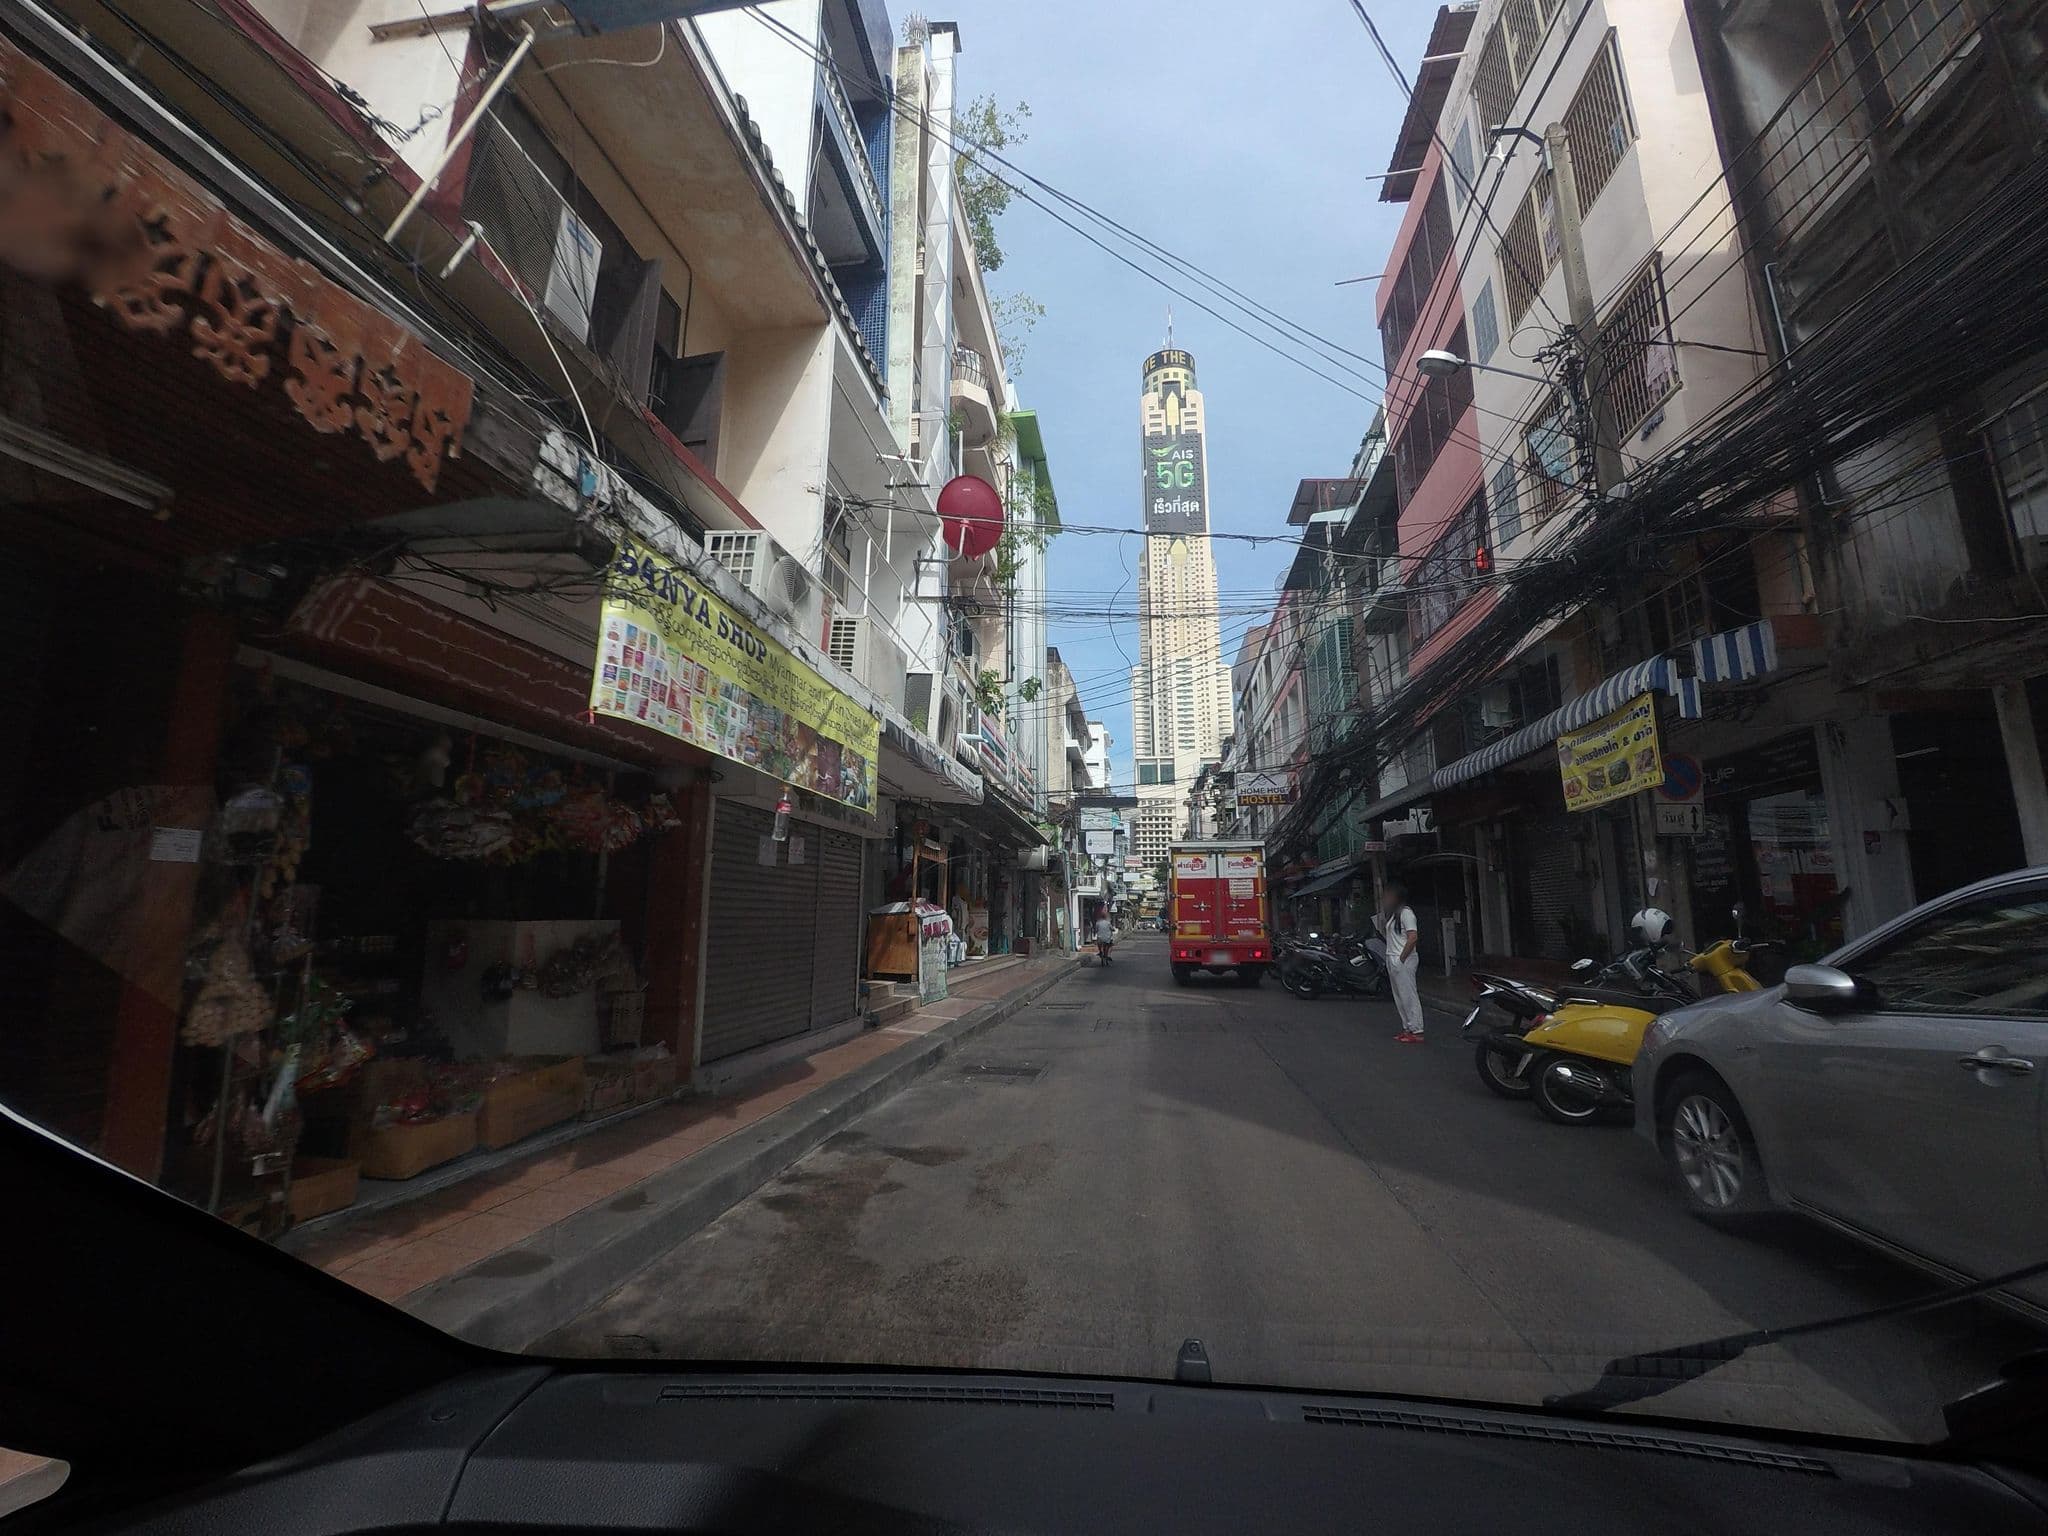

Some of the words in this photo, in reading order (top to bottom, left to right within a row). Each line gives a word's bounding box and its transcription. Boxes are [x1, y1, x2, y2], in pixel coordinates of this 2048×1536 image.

[1161, 350, 1186, 365] THE
[1171, 449, 1193, 459] AIS
[1156, 460, 1194, 488] 5G
[1153, 494, 1199, 516] เร็วที่สุด
[717, 611, 768, 664] SHOP
[769, 652, 807, 690] Myanmar
[1622, 736, 1630, 748] &
[1240, 794, 1286, 804] HOSTEL
